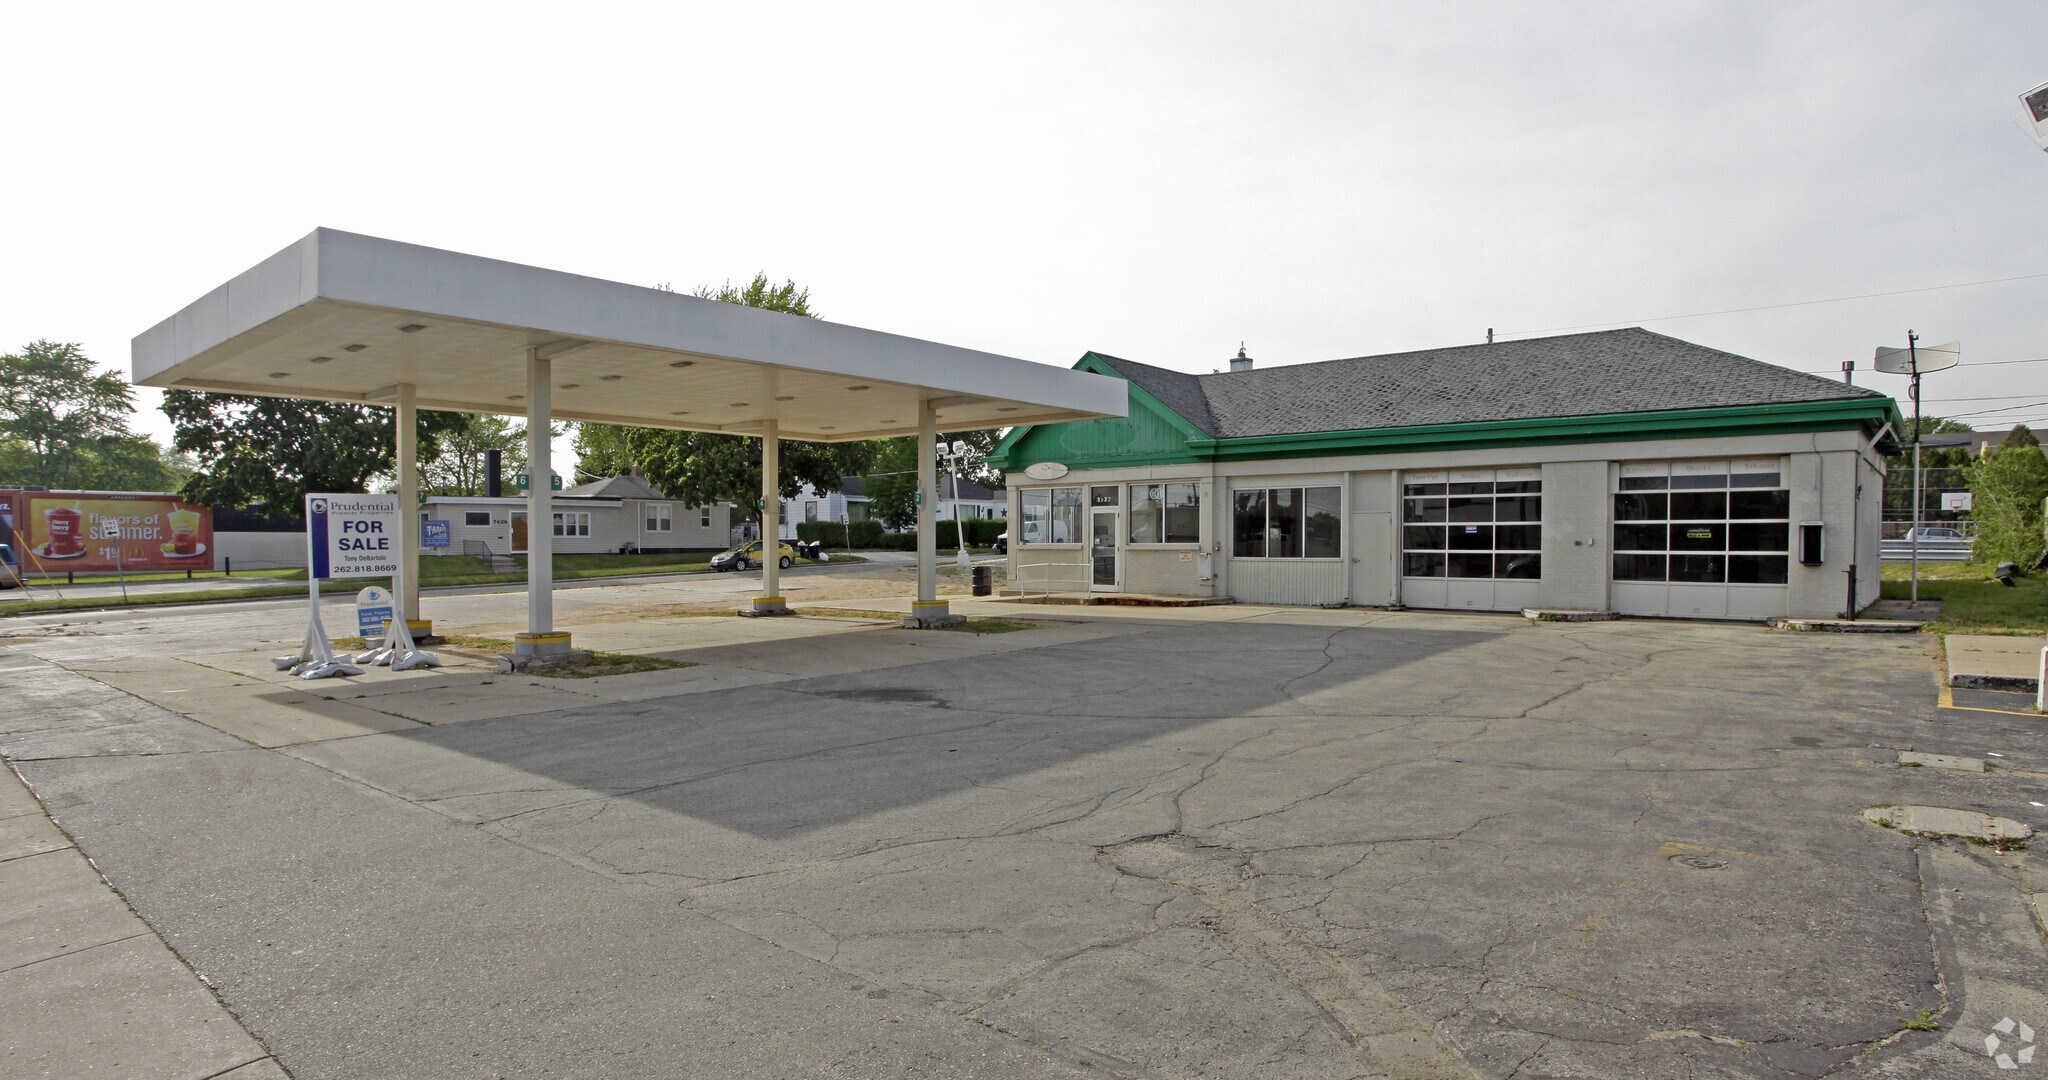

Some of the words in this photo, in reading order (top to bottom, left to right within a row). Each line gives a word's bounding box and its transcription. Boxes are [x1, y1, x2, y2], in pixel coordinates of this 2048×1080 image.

[1744, 462, 1774, 470] Exhaust
[520, 476, 526, 485] 6
[554, 477, 560, 486] 5
[419, 491, 424, 500] 7
[916, 494, 920, 502] 2
[331, 502, 394, 511] Prudential
[144, 514, 160, 525] of
[343, 520, 383, 534] FOR
[339, 537, 390, 551] SALE
[334, 564, 397, 573] 262.818.8669
